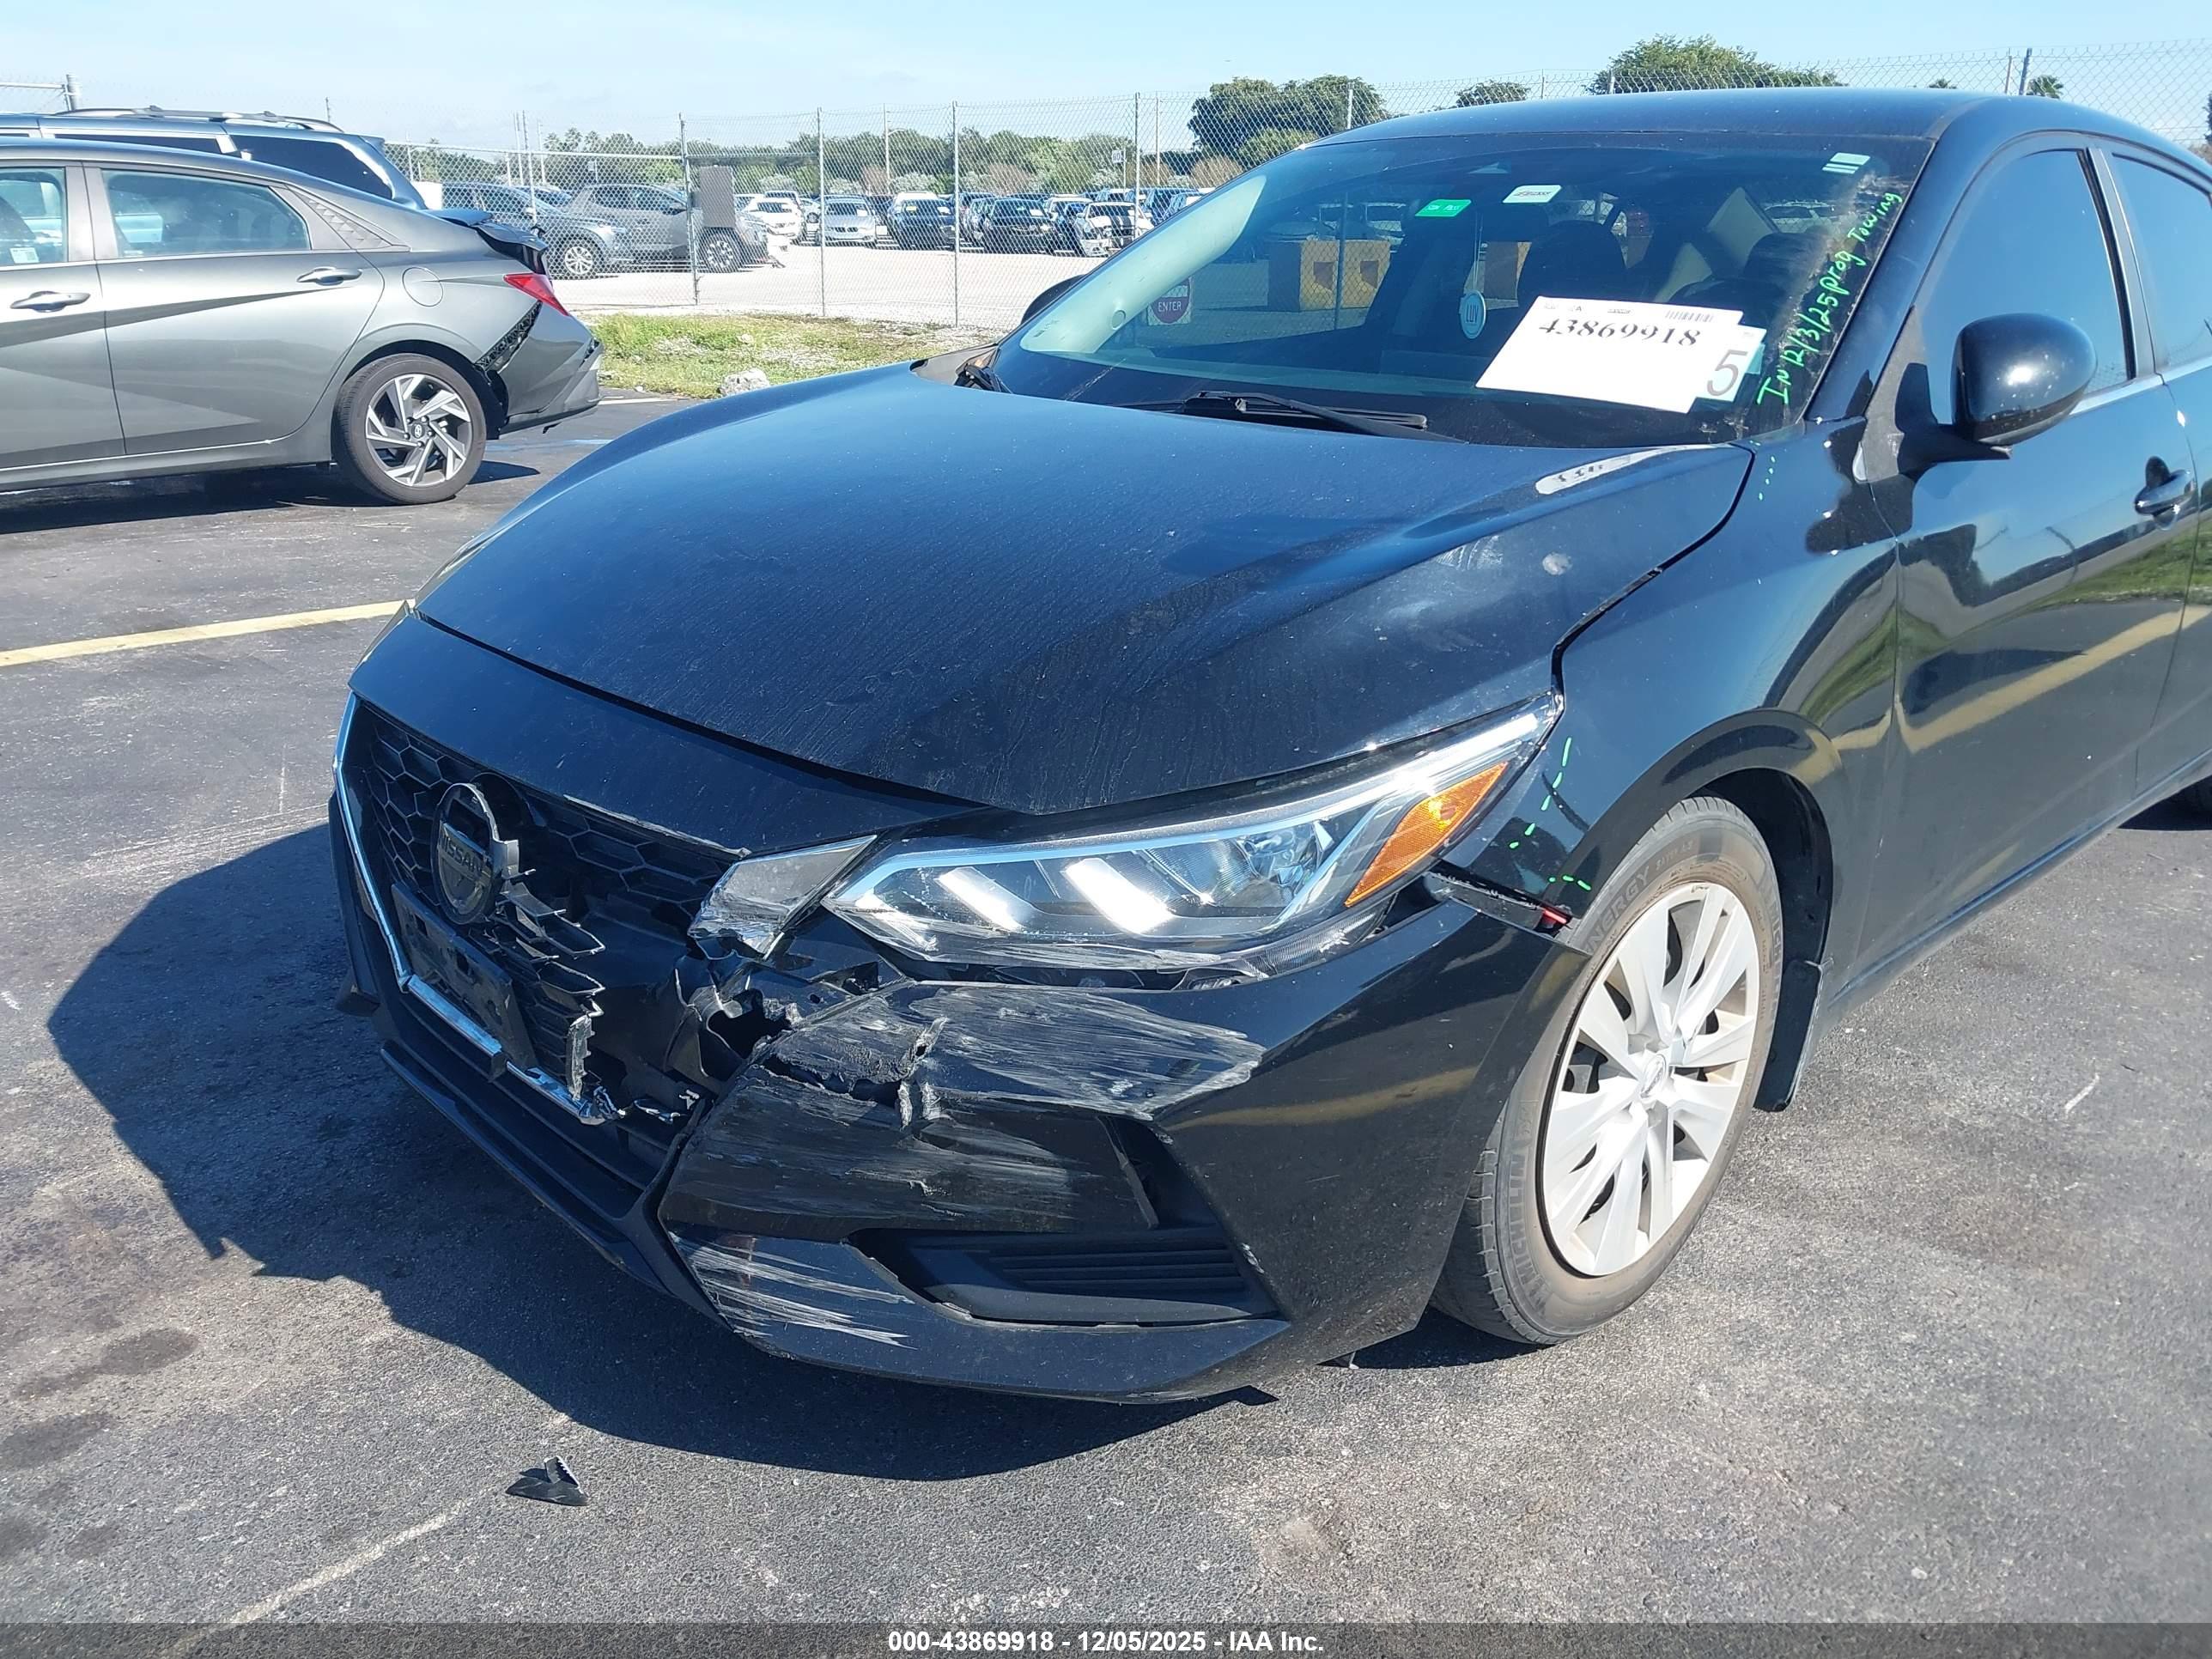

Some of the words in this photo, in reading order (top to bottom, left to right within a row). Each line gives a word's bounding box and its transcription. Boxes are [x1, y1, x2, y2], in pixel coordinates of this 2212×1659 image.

[1779, 292, 1838, 367] 12/3/25
[1847, 191, 1904, 243] Towing
[1538, 318, 1702, 346] 43869918
[1706, 349, 1749, 397] 5
